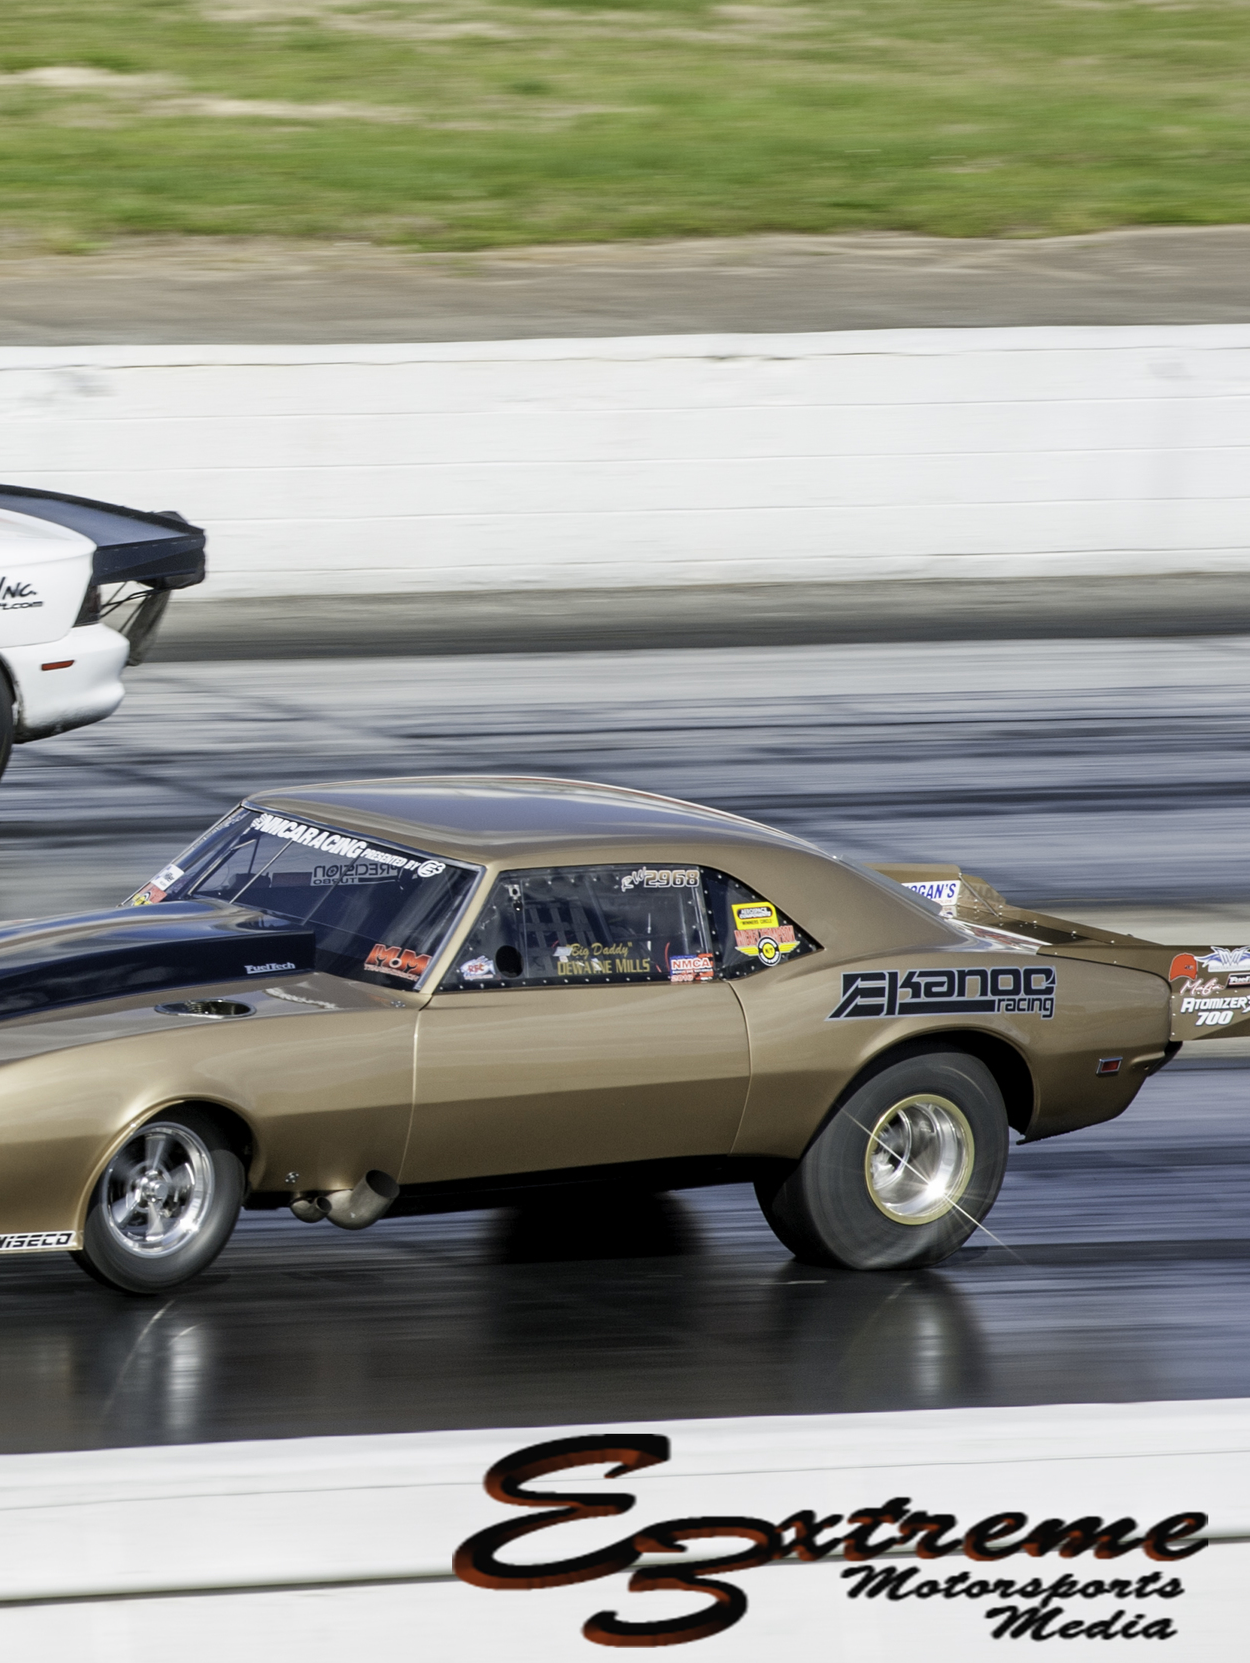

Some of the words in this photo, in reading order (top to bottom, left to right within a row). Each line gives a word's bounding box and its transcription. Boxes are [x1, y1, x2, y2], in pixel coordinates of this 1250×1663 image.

[360, 847, 405, 868] PRESENTED
[403, 858, 421, 872] BY
[643, 869, 700, 888] 2968
[244, 962, 296, 974] FuelTech
[614, 958, 650, 974] MILLS
[671, 957, 712, 970] NMCA
[996, 997, 1057, 1020] racing
[1180, 996, 1248, 1013] ATOMIZER
[1195, 1010, 1234, 1026] 700
